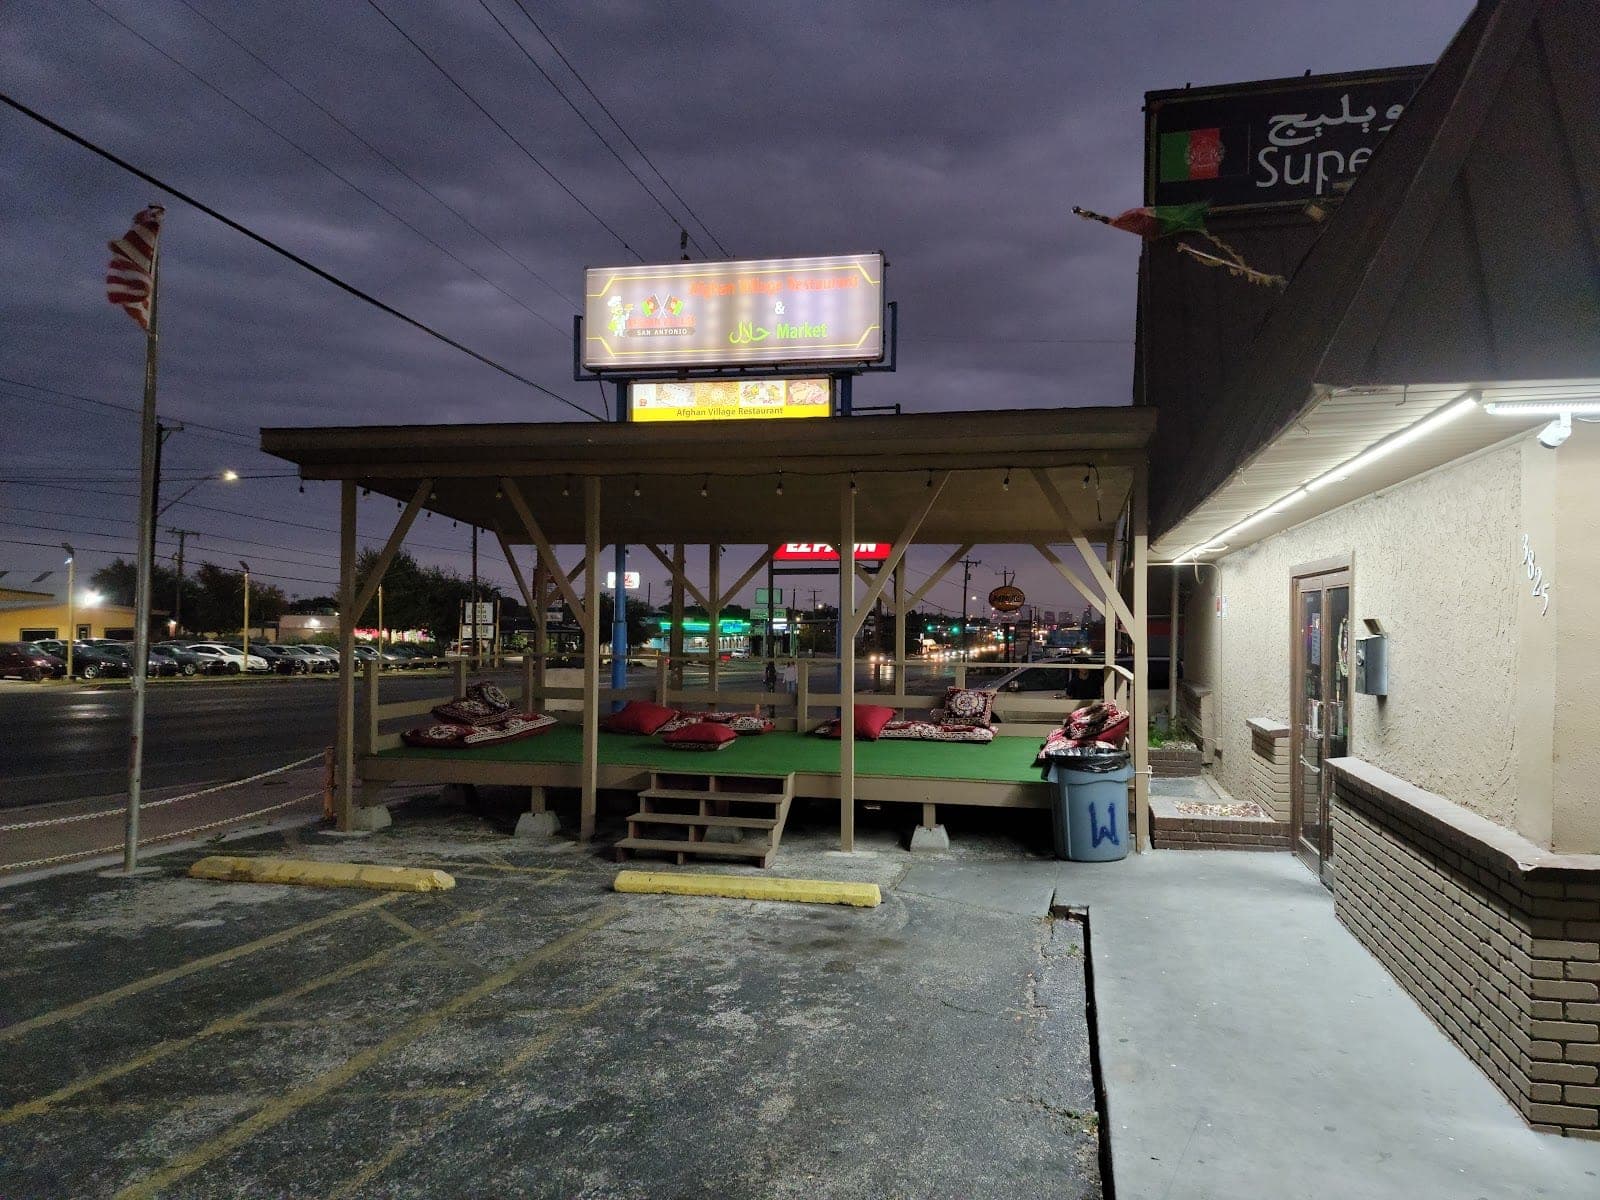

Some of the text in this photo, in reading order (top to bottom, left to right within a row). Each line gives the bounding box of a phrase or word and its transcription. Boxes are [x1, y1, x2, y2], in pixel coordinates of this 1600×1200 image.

[774, 301, 785, 315] &
[654, 328, 688, 336] ANTONIO
[776, 322, 828, 340] Market
[676, 407, 784, 417] Afghan Village Restaurant
[1522, 533, 1550, 617] 3825
[1088, 802, 1120, 848] W
